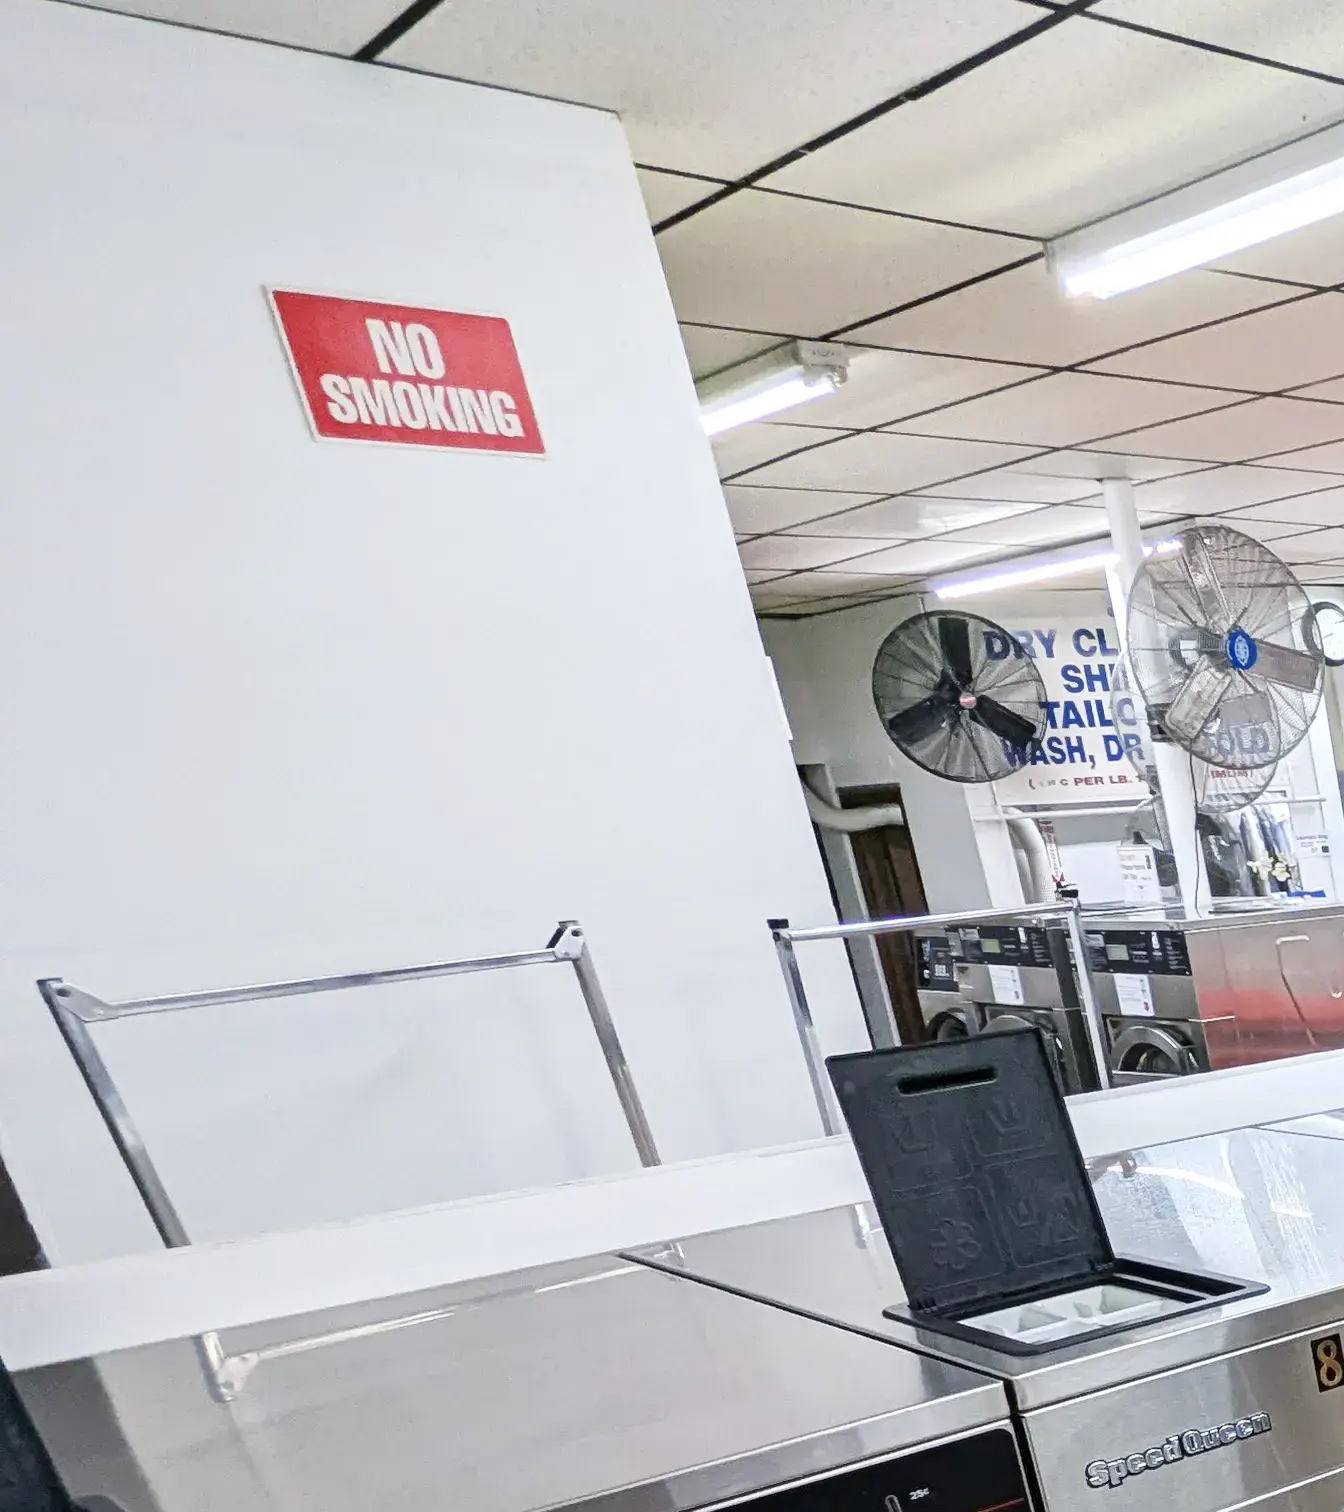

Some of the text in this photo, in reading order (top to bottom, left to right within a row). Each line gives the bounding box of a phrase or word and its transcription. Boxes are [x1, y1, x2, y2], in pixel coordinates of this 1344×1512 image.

[365, 318, 446, 380] NO
[319, 374, 525, 438] SMOKING
[1073, 627, 1120, 657] CL
[1103, 733, 1146, 761] DR
[1073, 776, 1105, 786] PER
[1314, 1338, 1344, 1389] 8
[1085, 1411, 1272, 1489] Speed Queen
